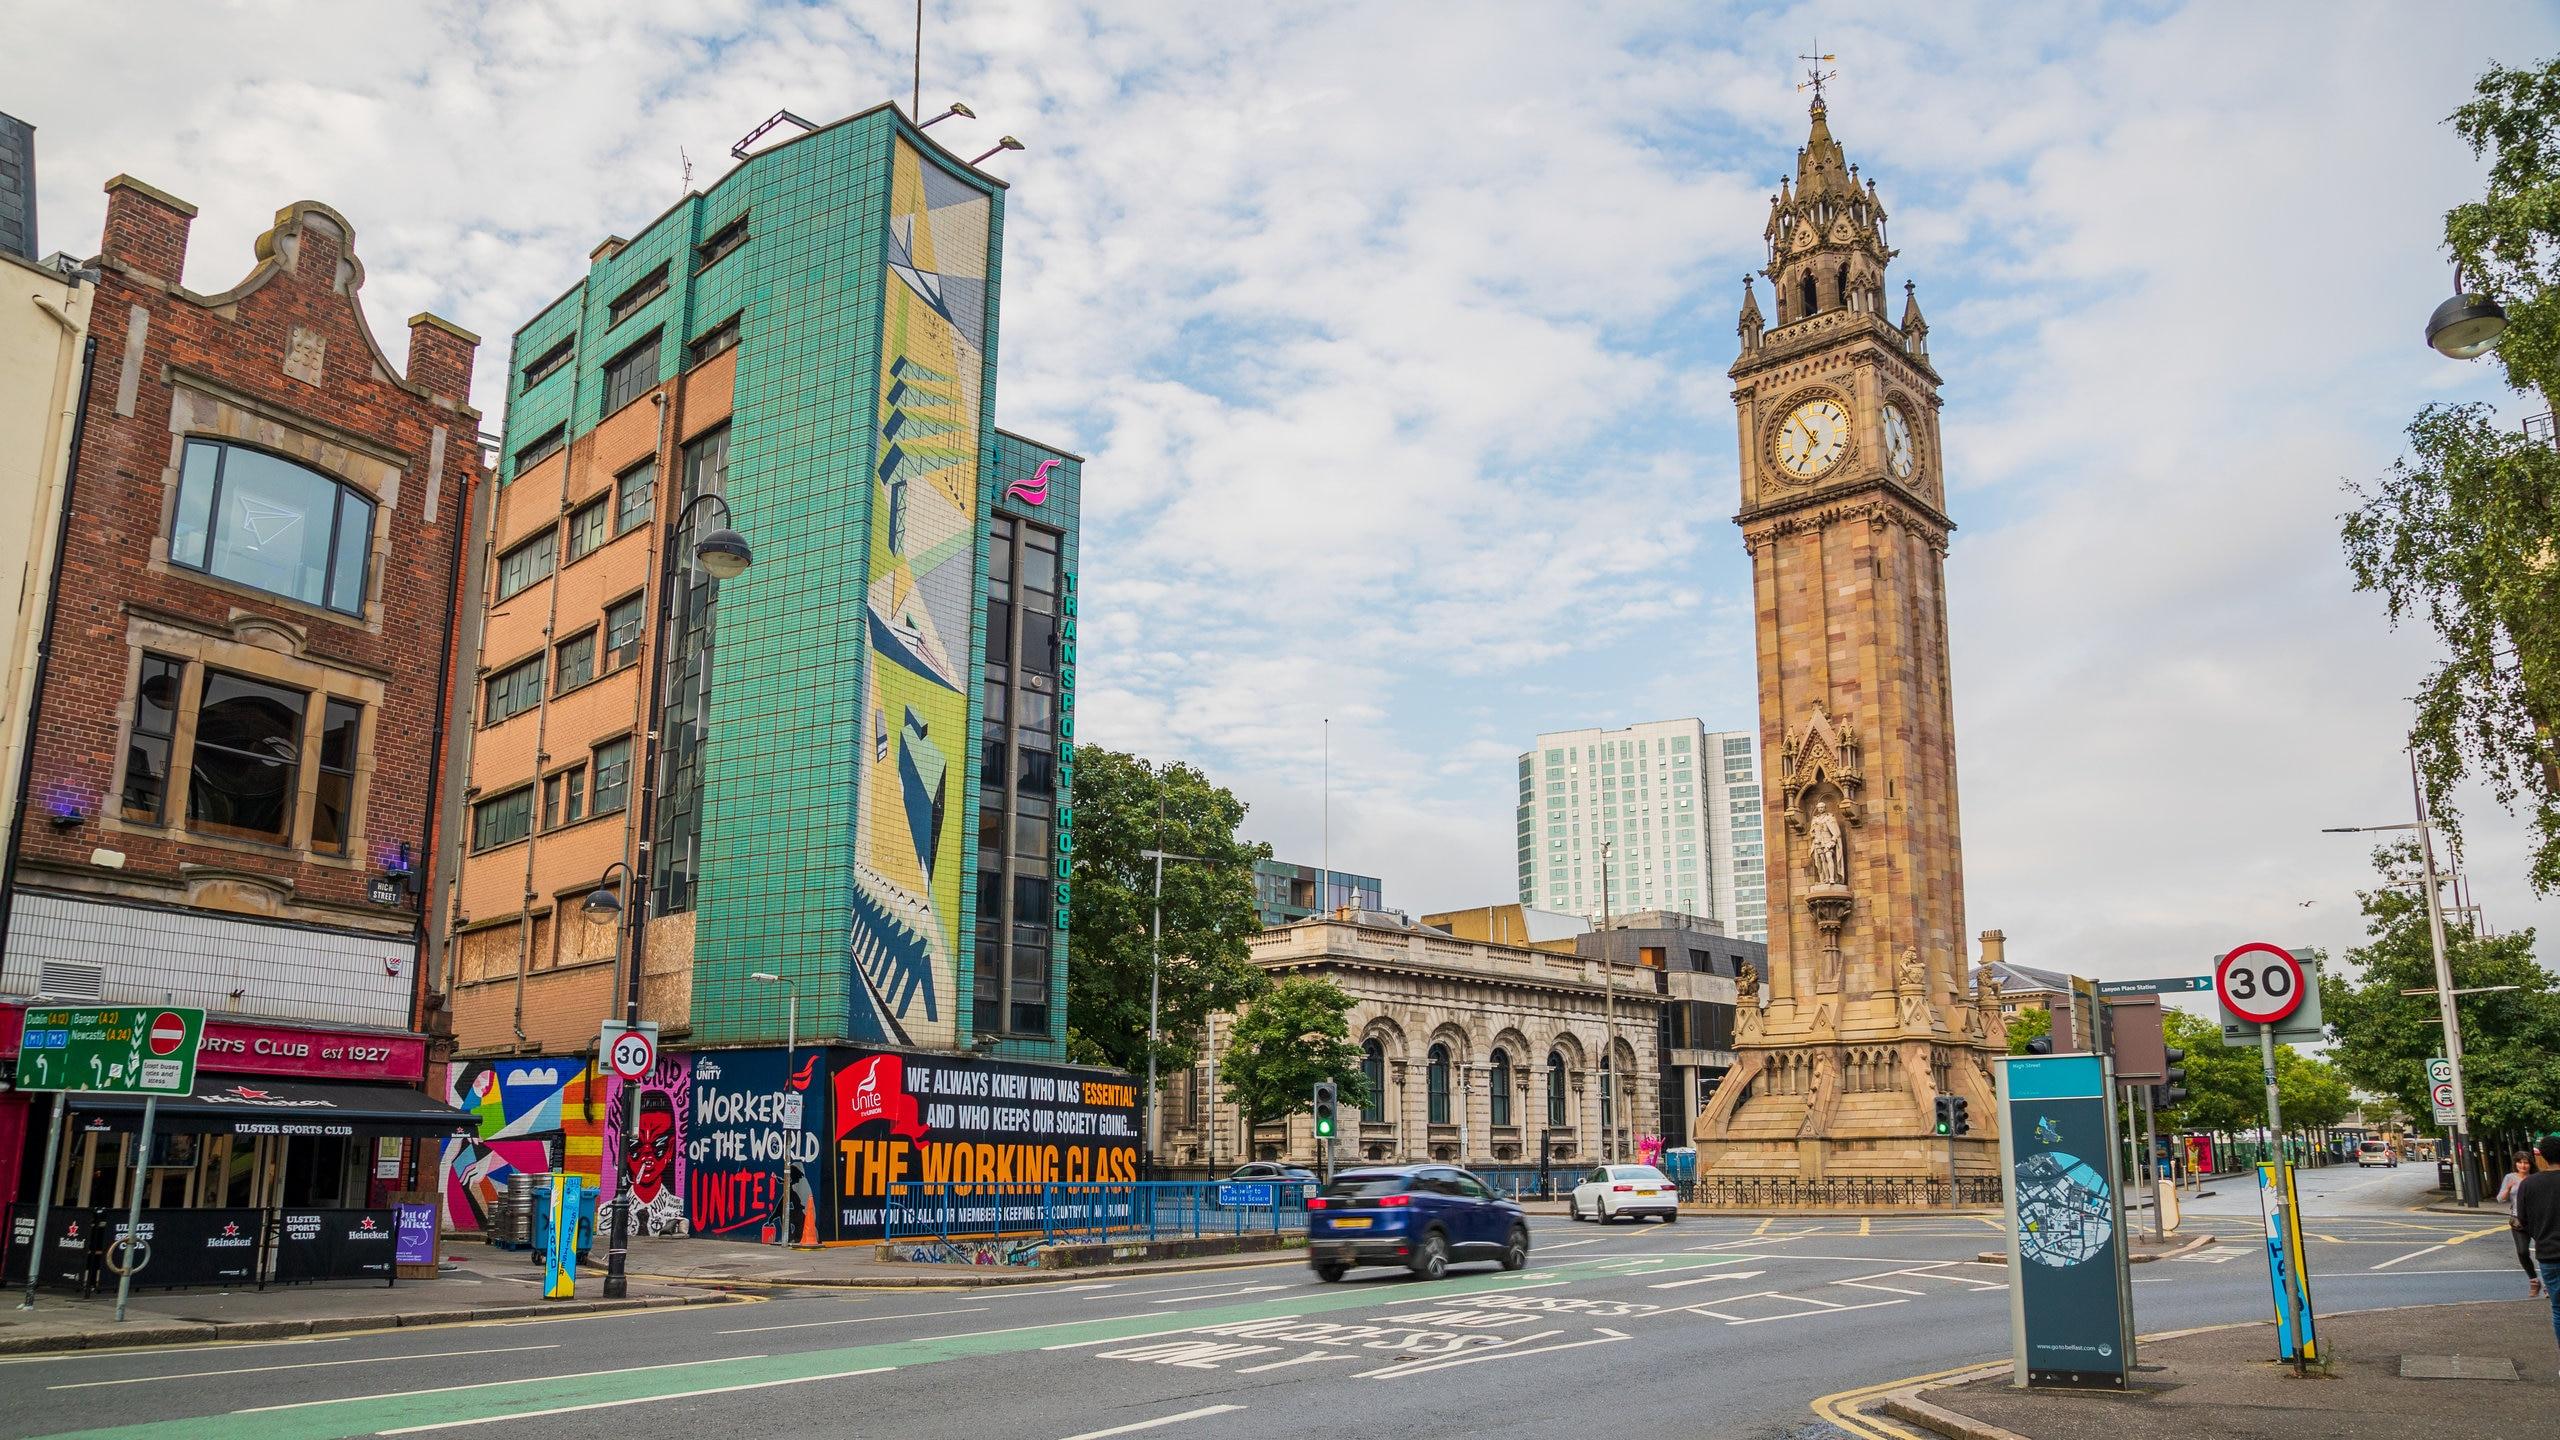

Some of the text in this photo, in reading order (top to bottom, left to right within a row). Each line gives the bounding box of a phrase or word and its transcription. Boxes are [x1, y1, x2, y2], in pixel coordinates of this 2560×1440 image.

[1057, 572, 1078, 930] TRANSPORT HOUSE
[377, 882, 394, 892] HIGH
[373, 890, 397, 902] STREET
[2229, 965, 2291, 999] 30
[27, 1013, 48, 1025] Dublin
[74, 1013, 98, 1026] Bangor
[71, 1029, 106, 1041] Newcastle
[199, 1037, 246, 1053] ORTS
[321, 1048, 344, 1060] est
[347, 1046, 391, 1062] 1927
[617, 1045, 647, 1067] 30
[696, 1069, 722, 1080] UNITY
[2433, 1066, 2451, 1077] 20
[907, 1066, 1137, 1107] WE ALWAYS KNEW WHO WAS 'ESSENTIAL'
[697, 1085, 801, 1126] WORKER
[926, 1103, 1138, 1136] AND WHO KEEPS OUR SOCIETY GOING...
[235, 1123, 353, 1135] ULSTER SPORTS CLUB
[689, 1127, 821, 1164] OF THE WORLD
[840, 1139, 1137, 1196] THE WORKING CLASS
[692, 1167, 776, 1232] UNITE!
[286, 1215, 321, 1224] ULSTER
[418, 1209, 432, 1221] of
[843, 1209, 877, 1226] THANK
[902, 1208, 915, 1224] TO
[917, 1207, 935, 1224] ALL
[1003, 1205, 1036, 1221] KEEPING
[1051, 1204, 1083, 1220] COUNTRY
[14, 1227, 34, 1236] SPORTS
[115, 1223, 155, 1232] ULTER
[286, 1224, 321, 1232] SPORTS
[15, 1236, 30, 1245] CLUB
[291, 1231, 316, 1240] CLUB
[348, 1230, 389, 1240] Heineken
[207, 1237, 250, 1248] Heineken
[549, 1223, 557, 1269] HAND
[1433, 1294, 1662, 1317] BUSES
[1366, 1310, 1543, 1328] AND
[1095, 1341, 1362, 1375] ONLY
